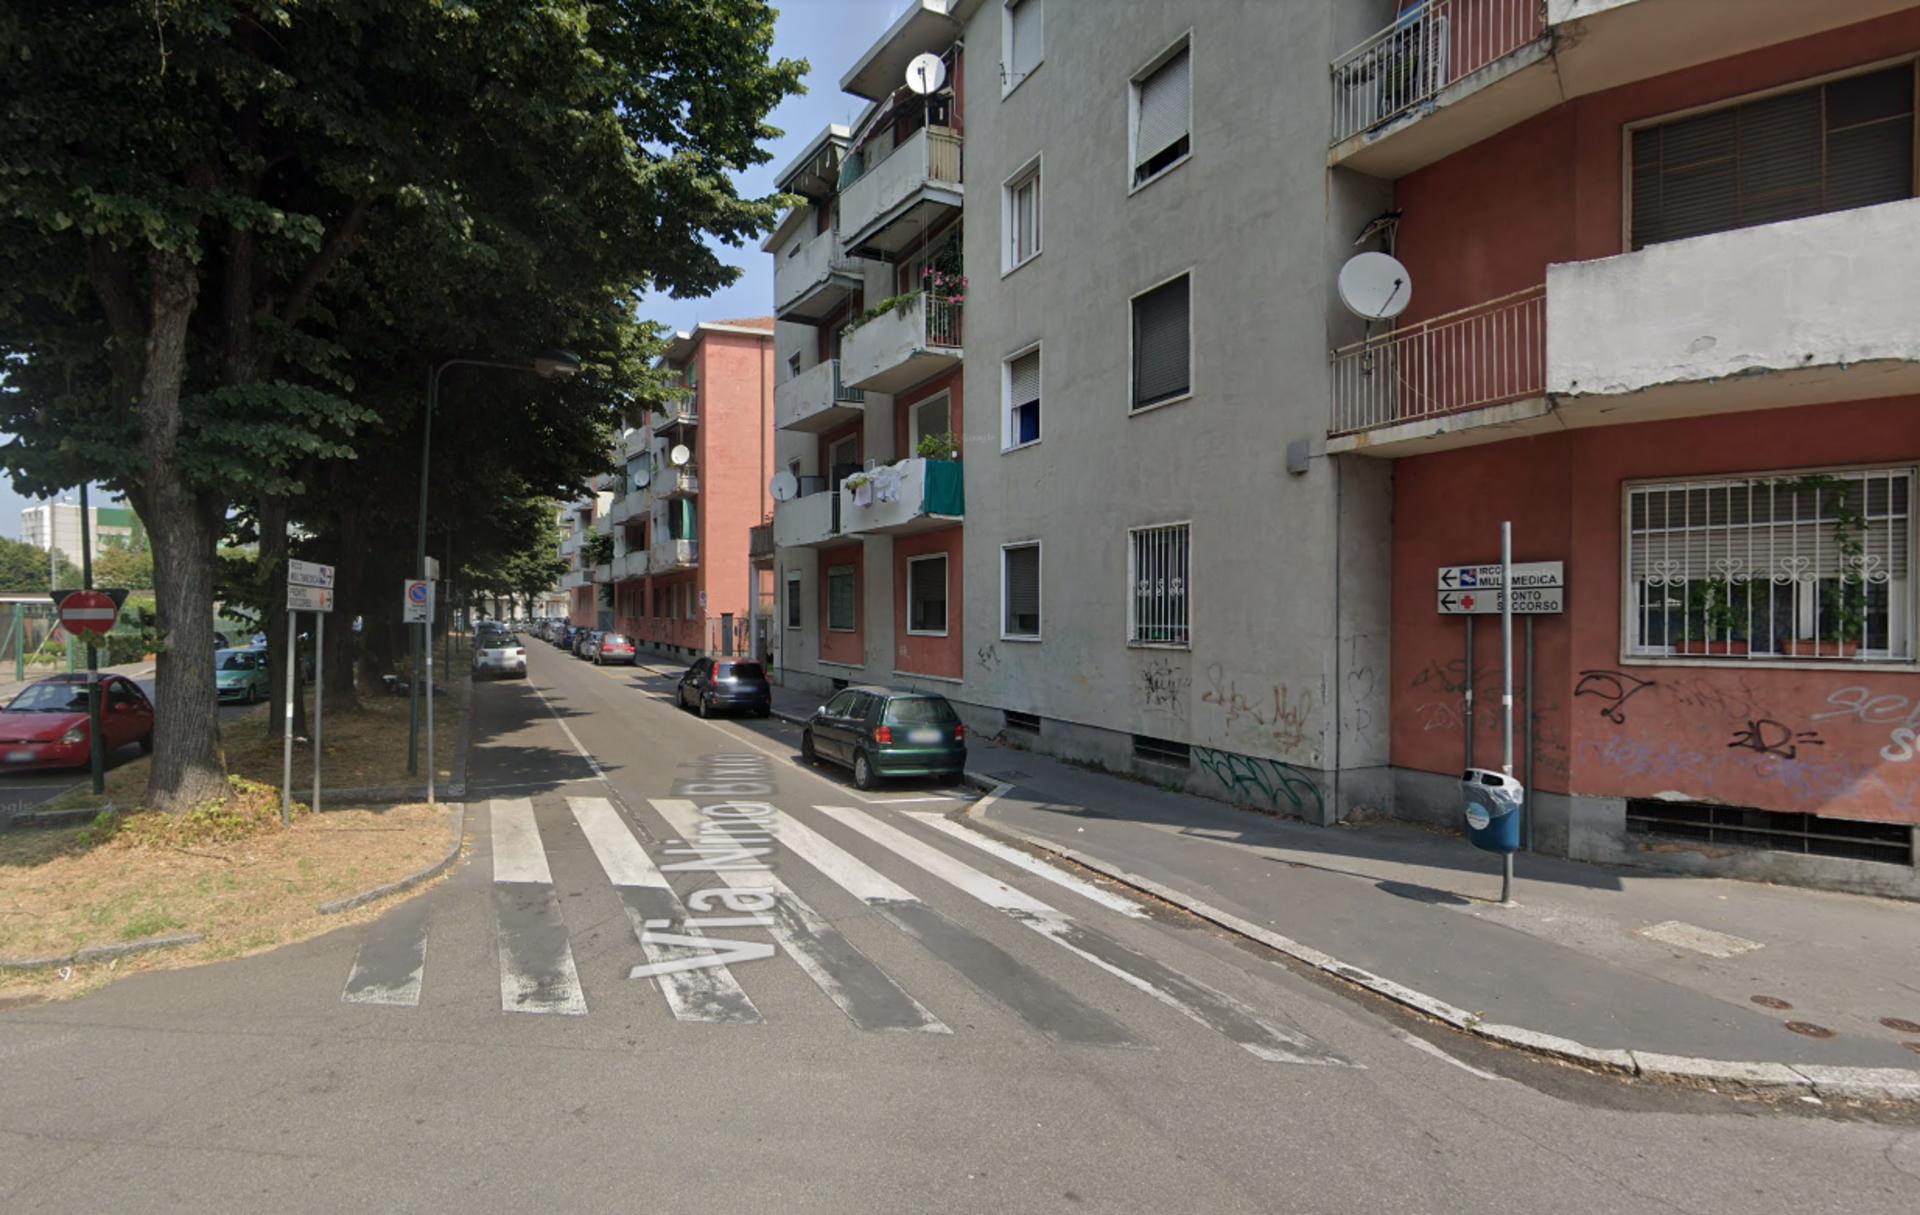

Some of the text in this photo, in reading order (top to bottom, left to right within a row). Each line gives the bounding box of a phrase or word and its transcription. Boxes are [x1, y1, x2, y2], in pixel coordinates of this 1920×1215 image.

[1479, 566, 1504, 575] IRCC
[1479, 574, 1557, 586] MULMEDICA
[1497, 590, 1541, 601] PONTO
[1497, 600, 1558, 611] SCCORSO
